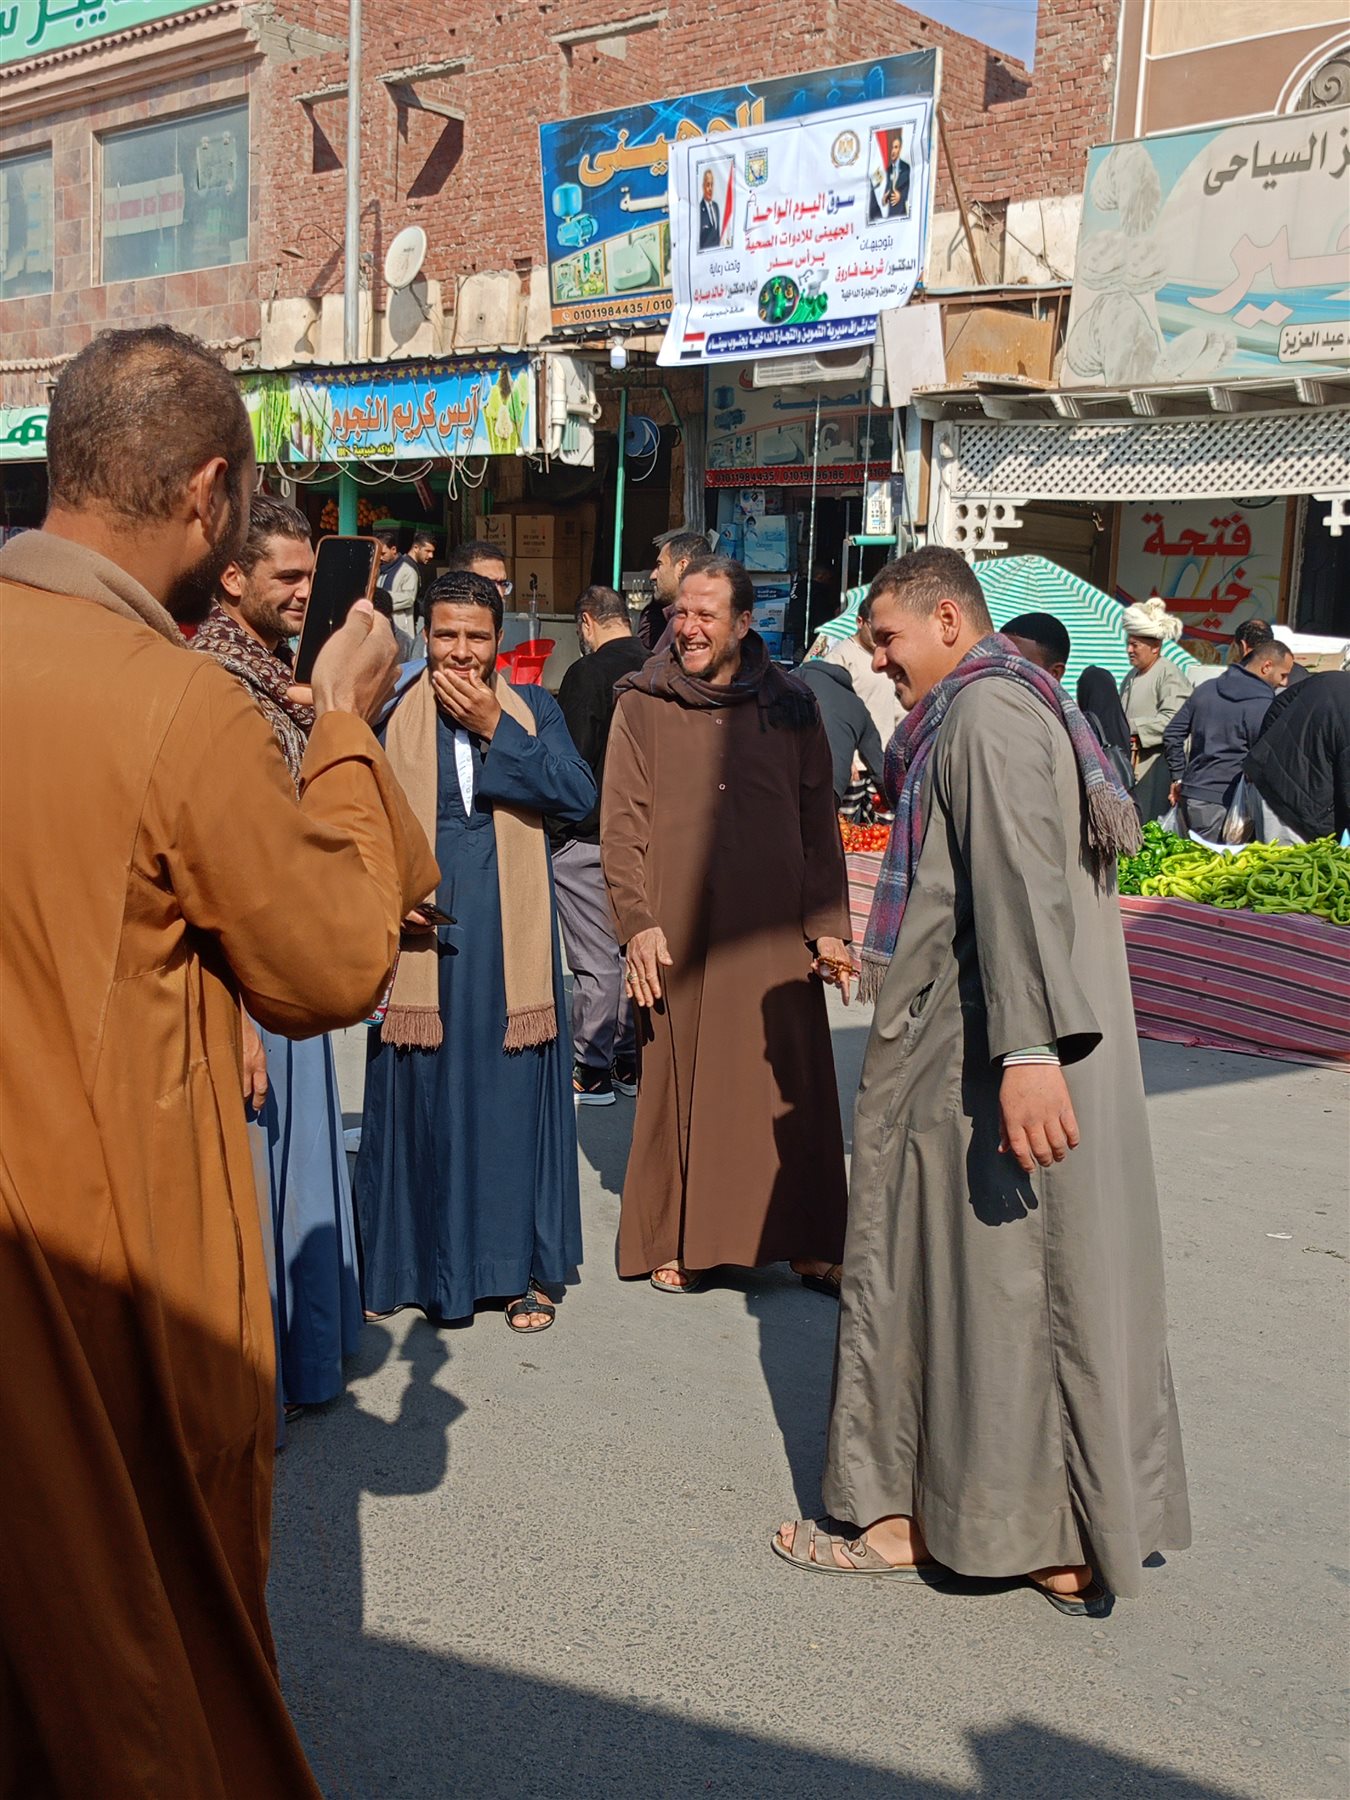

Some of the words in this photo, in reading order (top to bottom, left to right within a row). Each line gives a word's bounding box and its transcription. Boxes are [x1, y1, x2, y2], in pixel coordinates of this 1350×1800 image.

[1203, 130, 1327, 195] السياحى
[753, 198, 792, 224] الواحد
[793, 192, 825, 222] اليوم
[827, 189, 855, 215] سوق
[745, 235, 777, 254] الصحية
[859, 235, 893, 252] بتوجيهات
[710, 262, 723, 277] رعاية
[766, 257, 794, 272] سدر
[835, 262, 858, 282] فاروق
[860, 258, 884, 280] شريف
[879, 284, 897, 298] التموين
[573, 302, 642, 321] 01011984435
[749, 331, 774, 348] الداخلية
[774, 326, 802, 345] والتجارة
[802, 324, 826, 343] التموين
[827, 322, 848, 340] مديرية
[728, 333, 749, 350] بجنوب
[1282, 330, 1320, 355] العزيز
[1321, 331, 1344, 352] عبد
[332, 395, 388, 442] النجوم
[392, 389, 436, 443] كريم
[438, 385, 480, 439] آيس
[783, 469, 845, 481] 0101996186
[1141, 511, 1253, 556] فتحة
